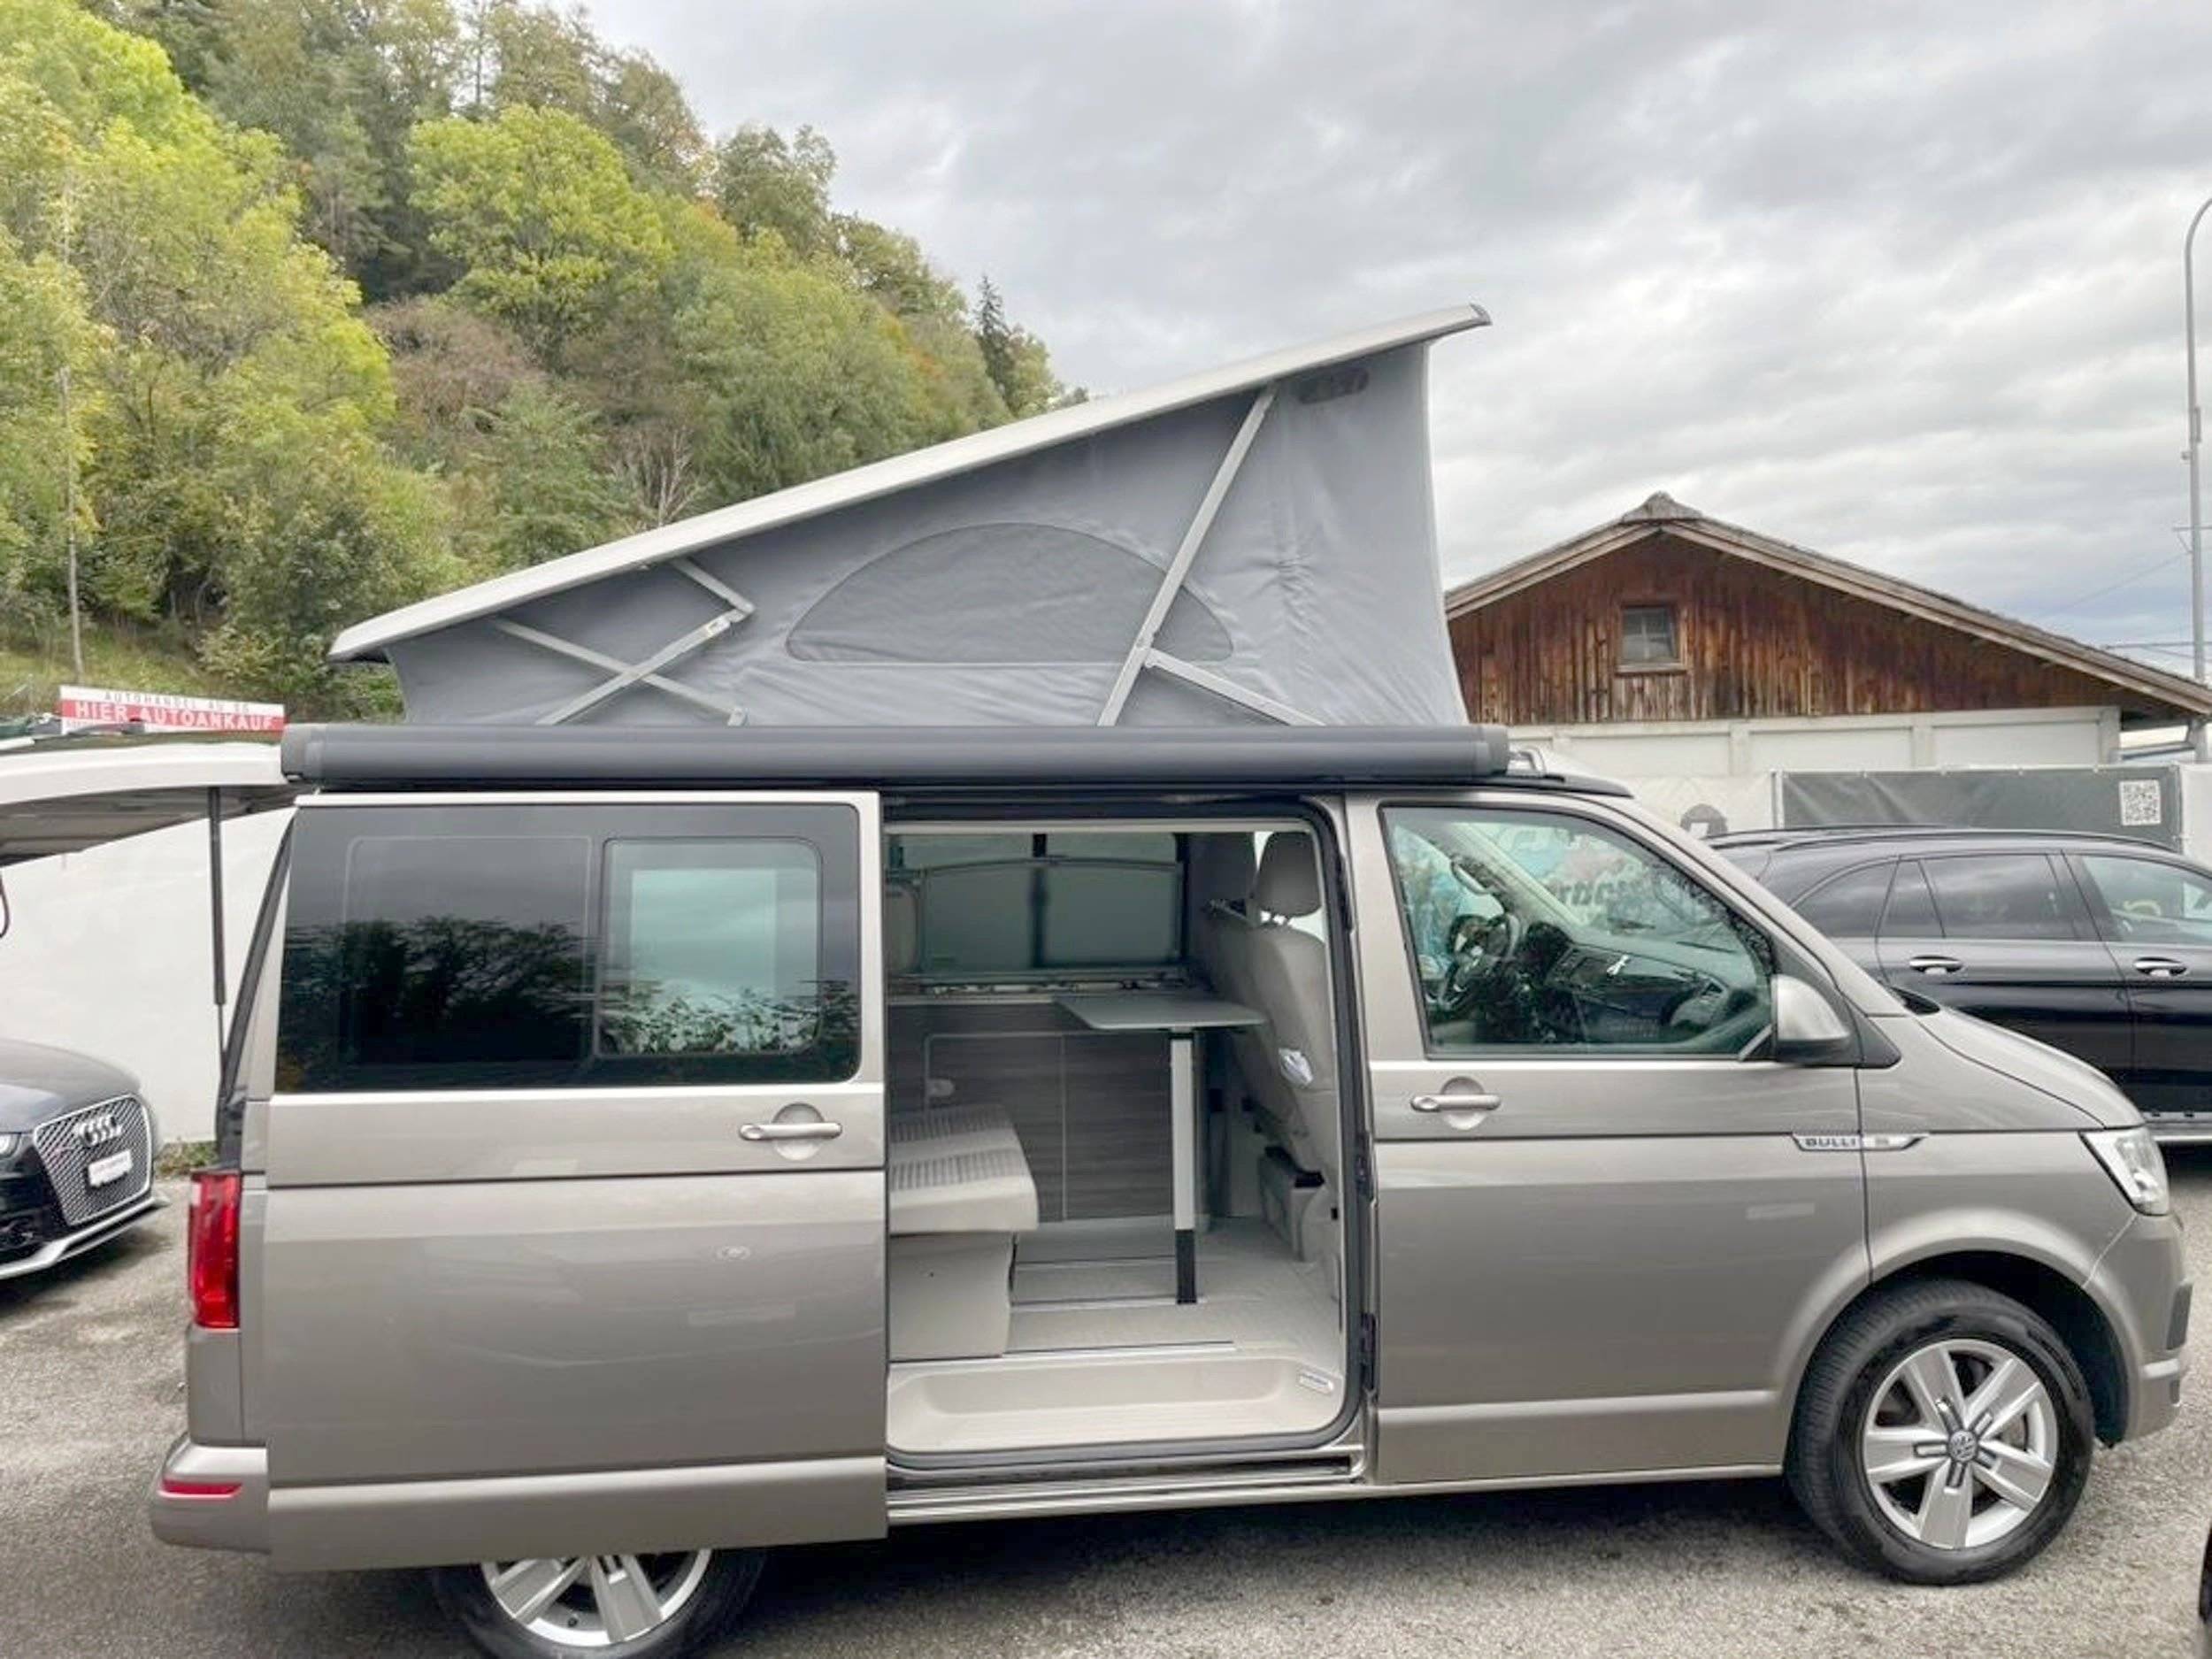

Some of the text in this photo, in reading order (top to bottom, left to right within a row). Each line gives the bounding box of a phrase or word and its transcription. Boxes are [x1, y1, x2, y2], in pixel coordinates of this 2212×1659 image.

[75, 701, 128, 723] HIER
[139, 706, 276, 731] AUTOANKAUF
[1805, 1137, 1856, 1148] BULLI
